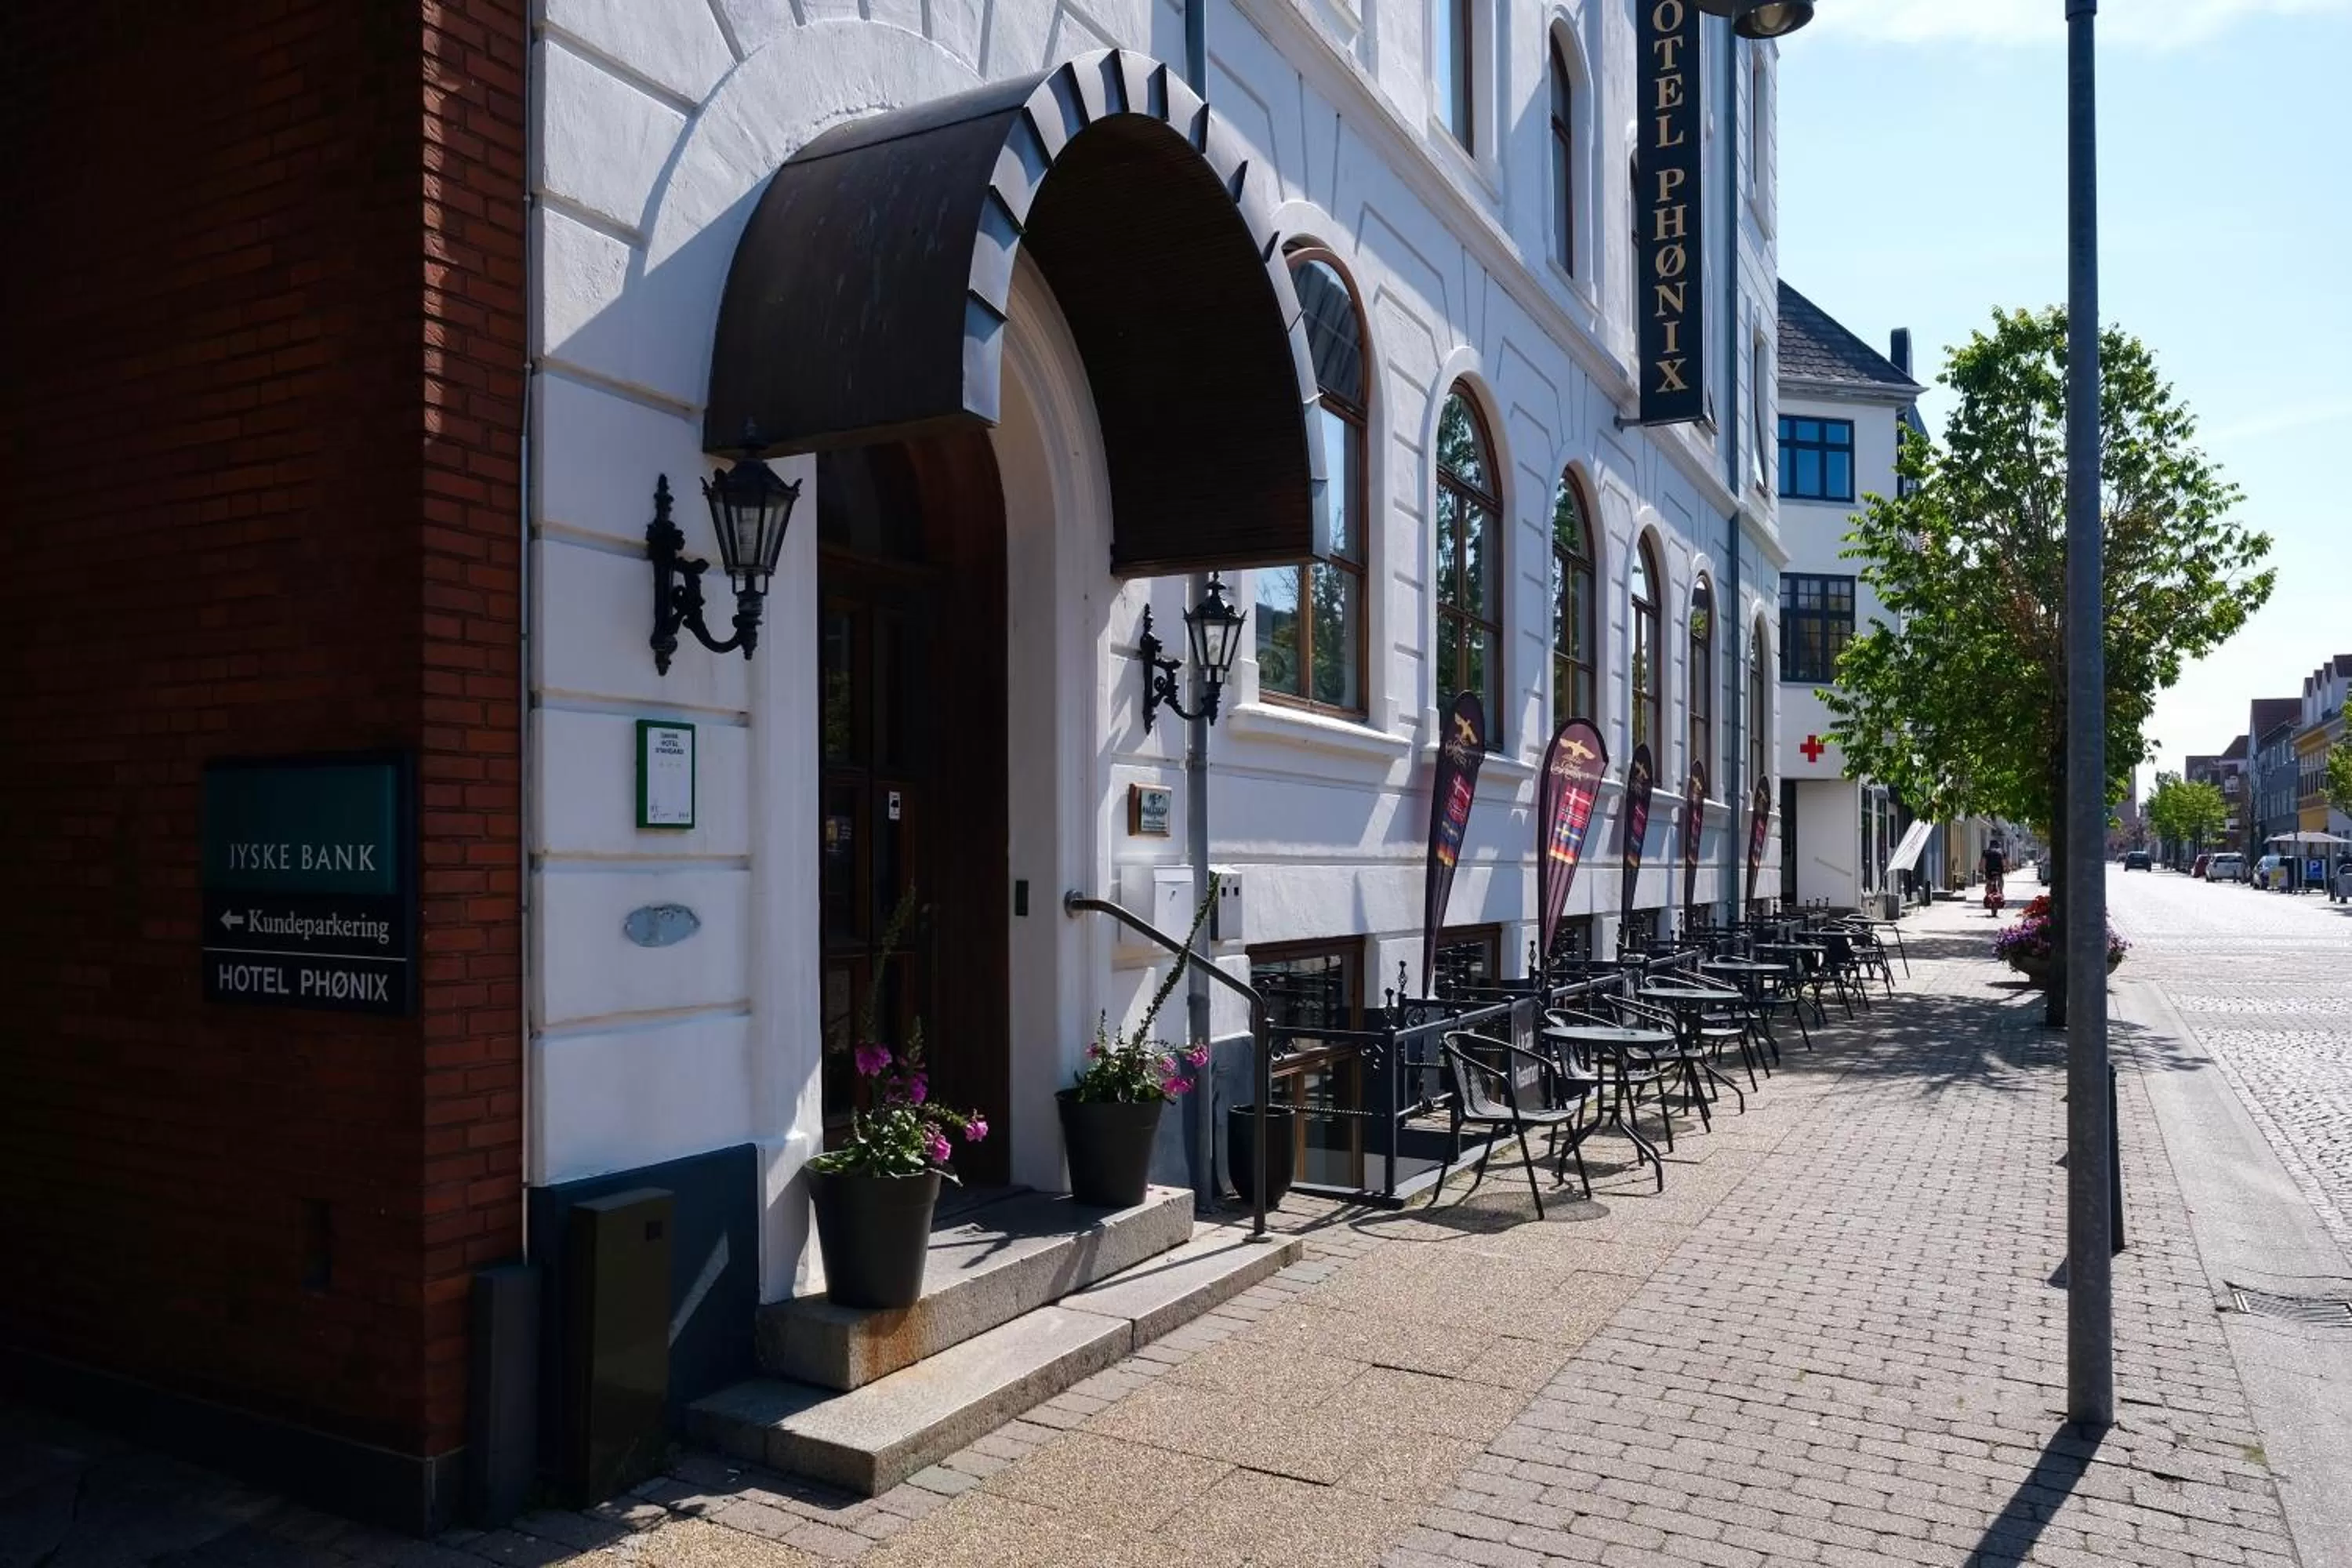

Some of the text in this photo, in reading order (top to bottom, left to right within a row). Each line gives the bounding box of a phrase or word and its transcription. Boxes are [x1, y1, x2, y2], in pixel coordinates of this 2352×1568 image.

[1652, 0, 1690, 393] OTEL PHØNIX
[229, 843, 376, 872] JYSKE BANK
[248, 909, 390, 945] Kundeparkering
[217, 963, 390, 1003] HOTEL PHØNIX
